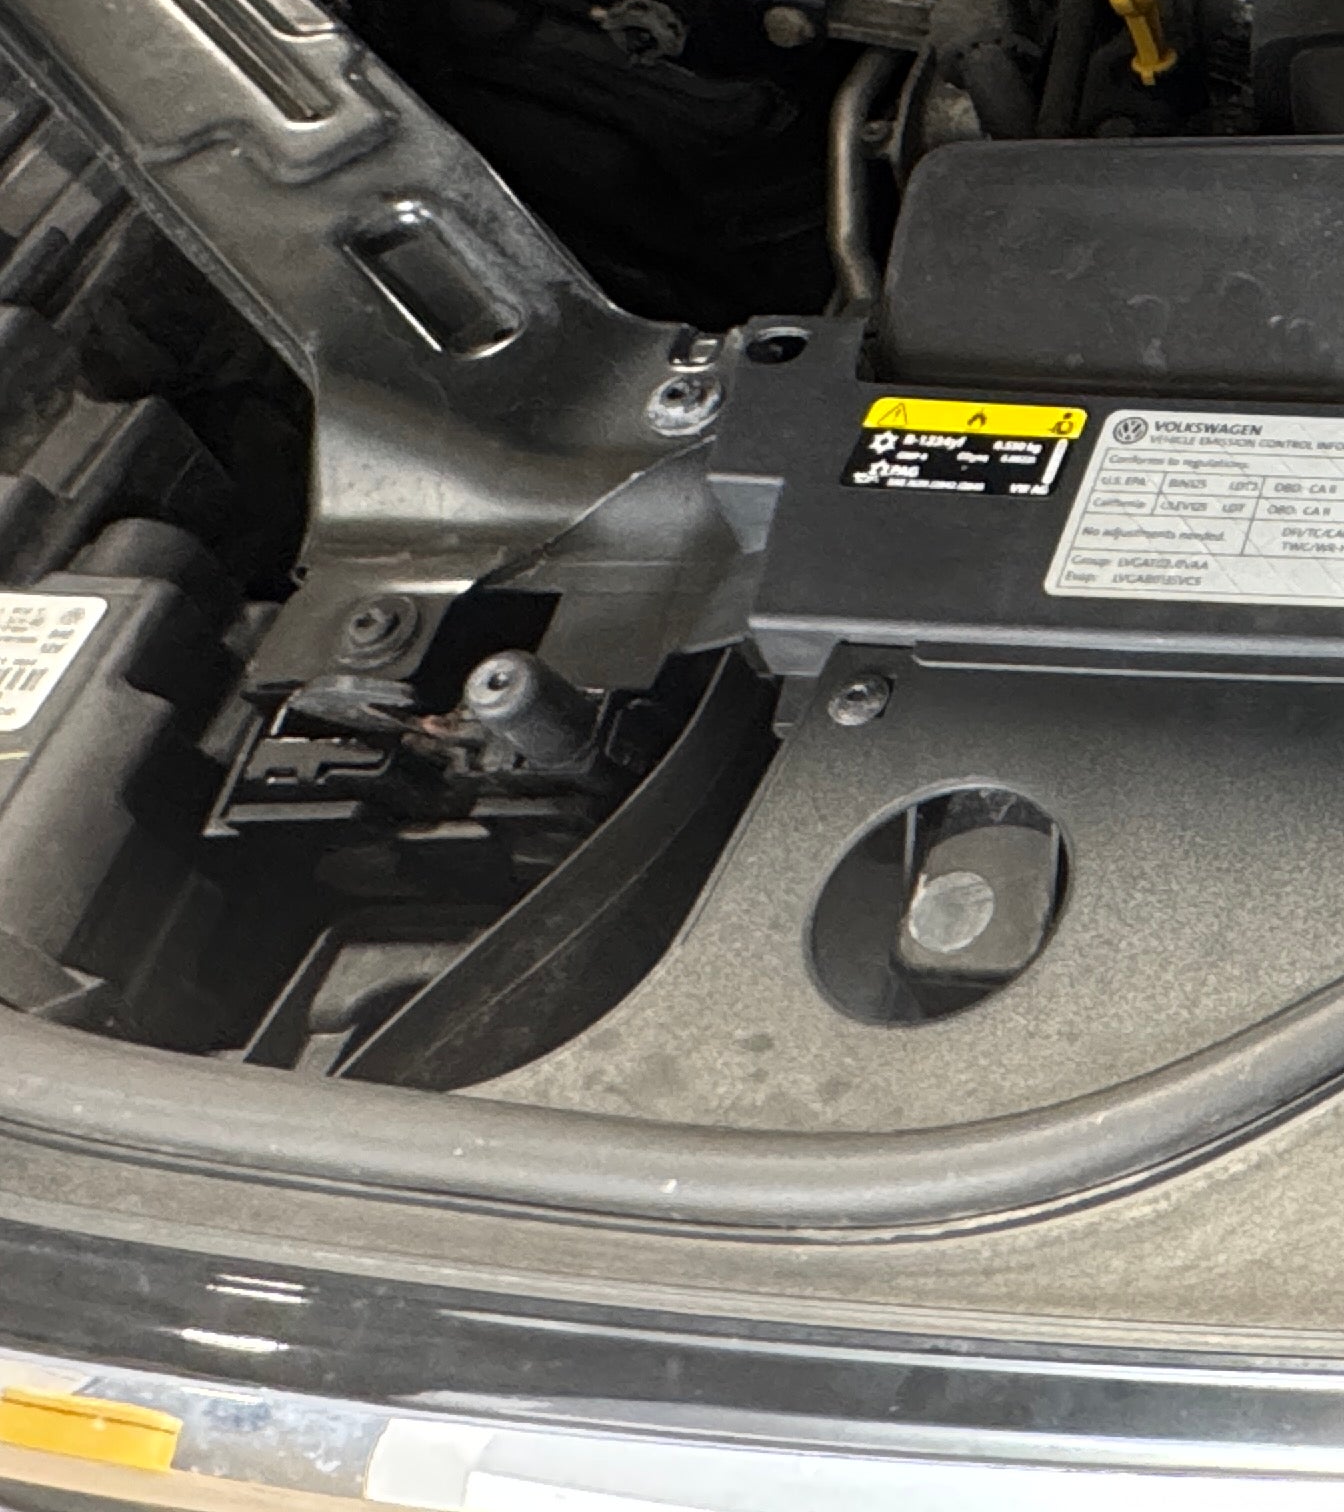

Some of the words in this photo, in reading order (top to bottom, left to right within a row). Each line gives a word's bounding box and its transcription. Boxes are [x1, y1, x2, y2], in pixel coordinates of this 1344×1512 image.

[1154, 420, 1262, 436] VOLKSWAGEN
[1150, 435, 1195, 446] VEHICLE
[1198, 437, 1256, 448] EMISSION
[1258, 439, 1313, 450] CONTROL
